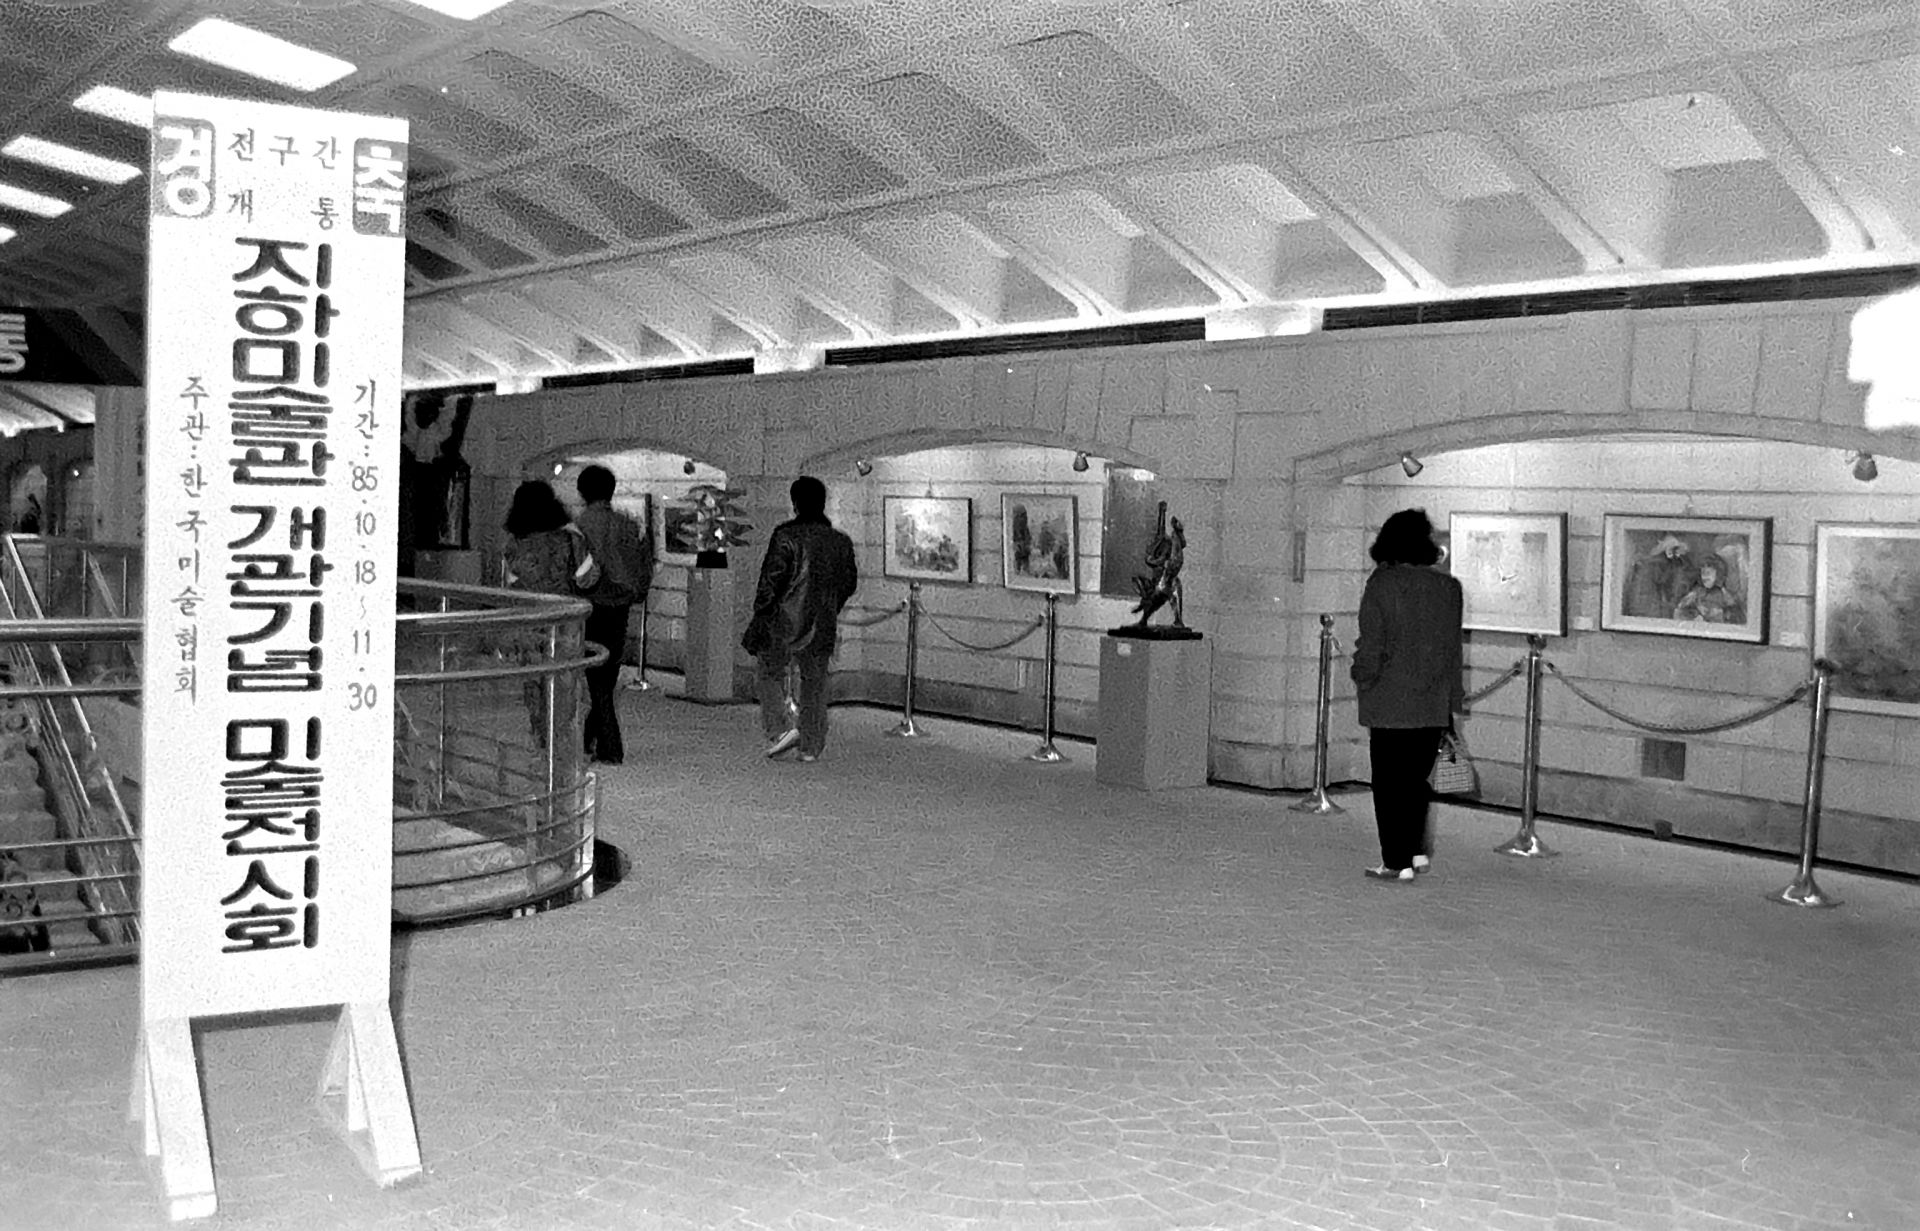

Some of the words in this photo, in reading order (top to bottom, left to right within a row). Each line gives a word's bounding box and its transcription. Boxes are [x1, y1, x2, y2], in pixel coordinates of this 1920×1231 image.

[227, 236, 341, 487] 지하미술관
[225, 505, 335, 693] 개관기념
[219, 715, 325, 954] 미술전시회
